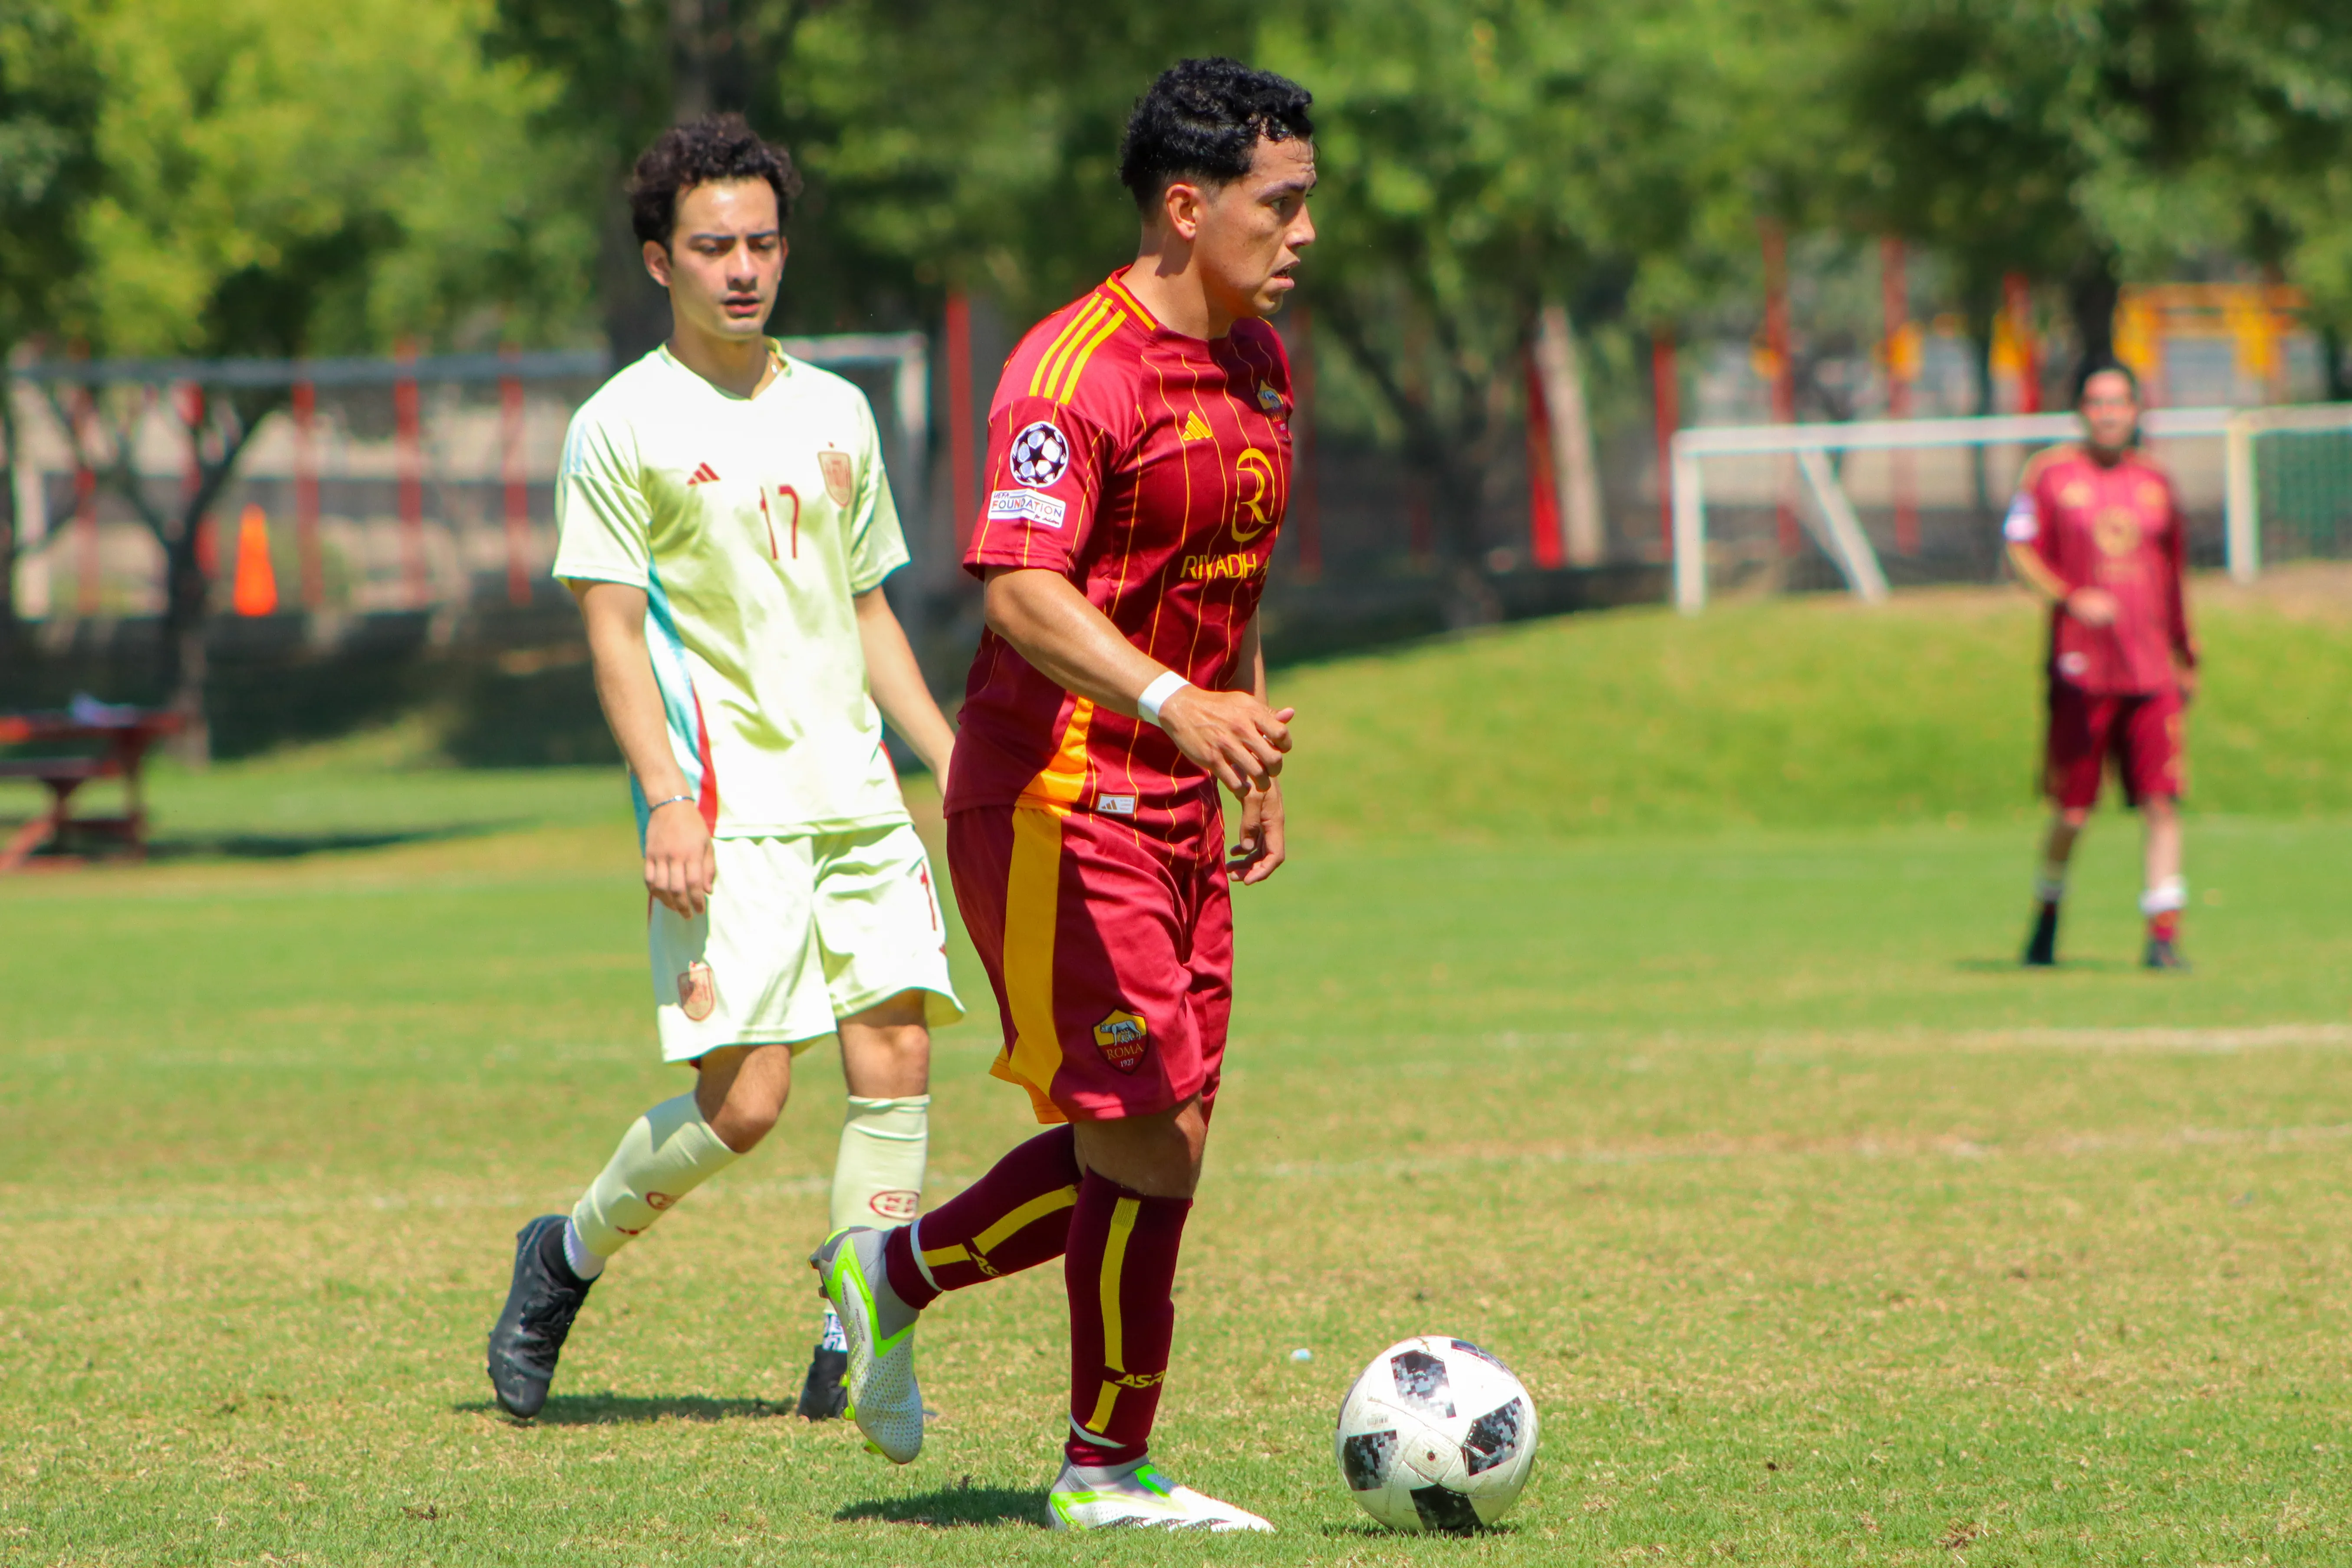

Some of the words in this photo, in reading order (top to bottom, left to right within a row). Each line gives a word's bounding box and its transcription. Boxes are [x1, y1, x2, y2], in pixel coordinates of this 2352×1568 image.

[992, 498, 1062, 518] FOUNDATION
[759, 484, 800, 560] 17
[1179, 553, 1257, 580] RIYADH
[1106, 1043, 1144, 1060] ROMA
[1120, 1058, 1134, 1067] 1927
